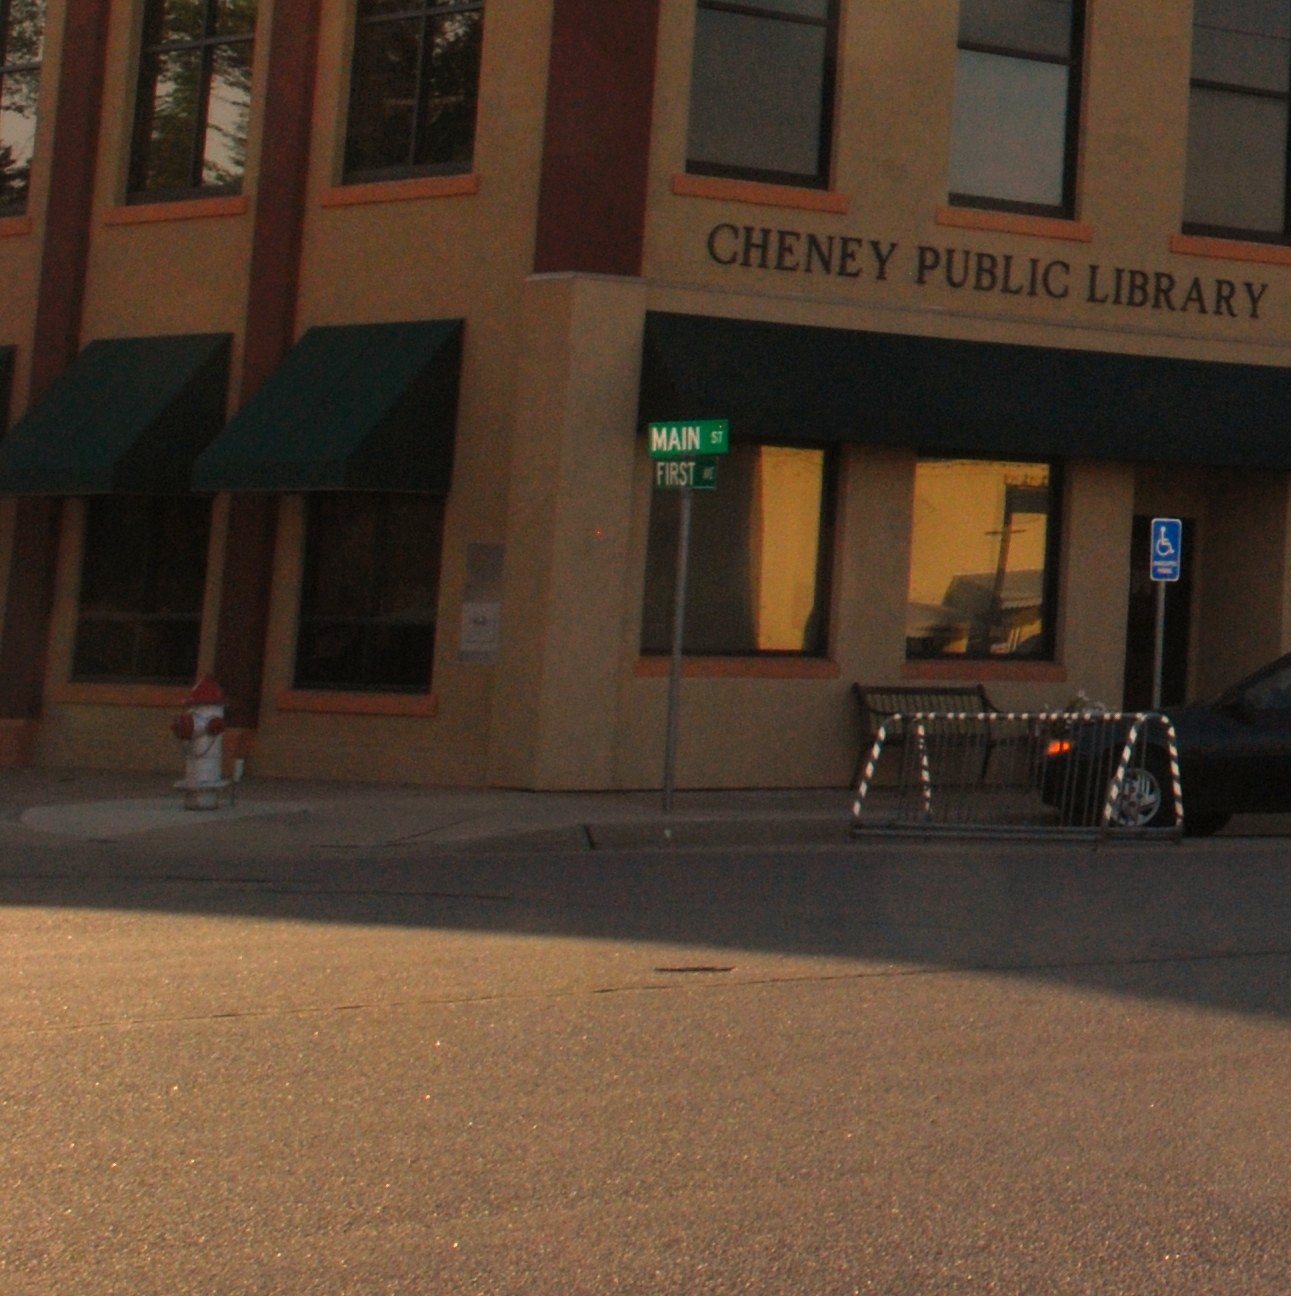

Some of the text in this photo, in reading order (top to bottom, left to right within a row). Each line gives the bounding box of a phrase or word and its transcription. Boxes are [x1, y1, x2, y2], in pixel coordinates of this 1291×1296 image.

[707, 223, 1269, 319] CHENEY PUBLIC LIBRARY
[651, 426, 724, 452] MAIN ST
[656, 461, 697, 486] FIRST
